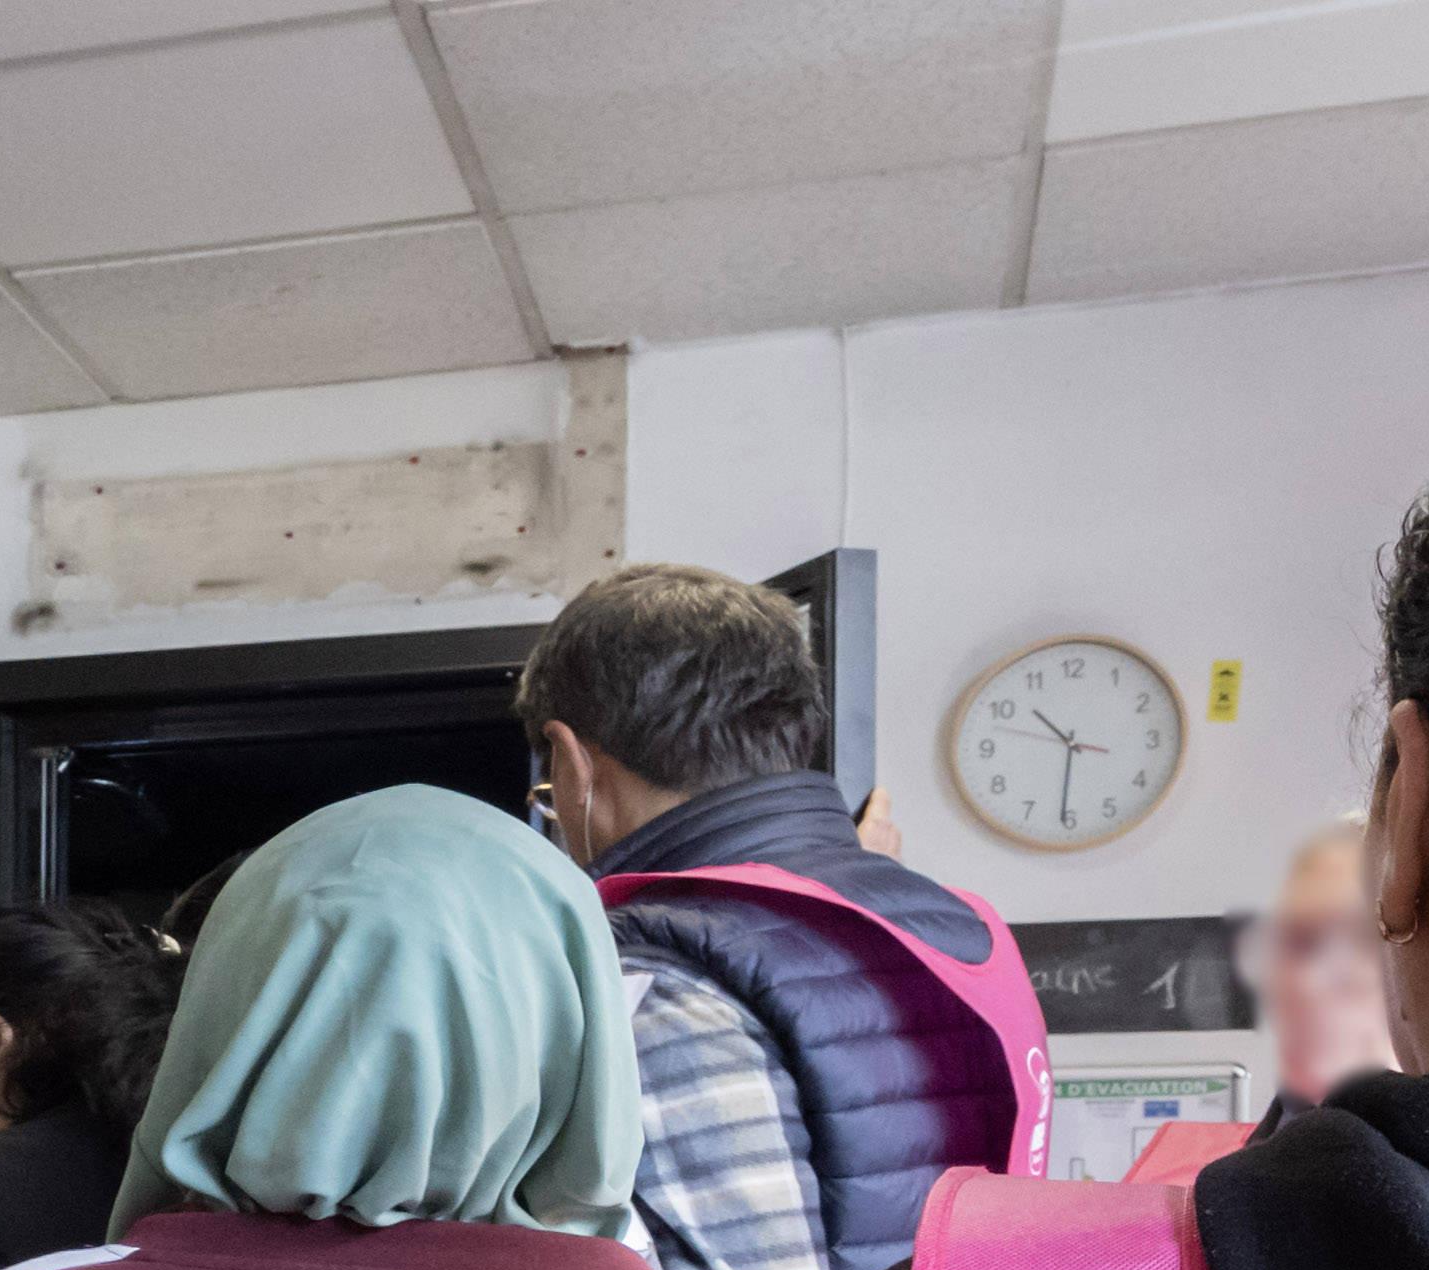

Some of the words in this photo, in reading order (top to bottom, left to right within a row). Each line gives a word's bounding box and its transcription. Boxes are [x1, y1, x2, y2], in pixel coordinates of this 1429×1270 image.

[1060, 657, 1086, 680] 12
[1110, 666, 1121, 689] 1
[1025, 671, 1044, 691] 11
[989, 698, 1016, 720] 10
[1135, 692, 1150, 714] 2
[978, 738, 995, 759] 9
[1145, 728, 1161, 750] 3
[990, 773, 1007, 795] 8
[1131, 769, 1148, 789] 4
[1022, 799, 1037, 821] 7
[1062, 808, 1078, 831] 6
[1101, 797, 1118, 820] 5
